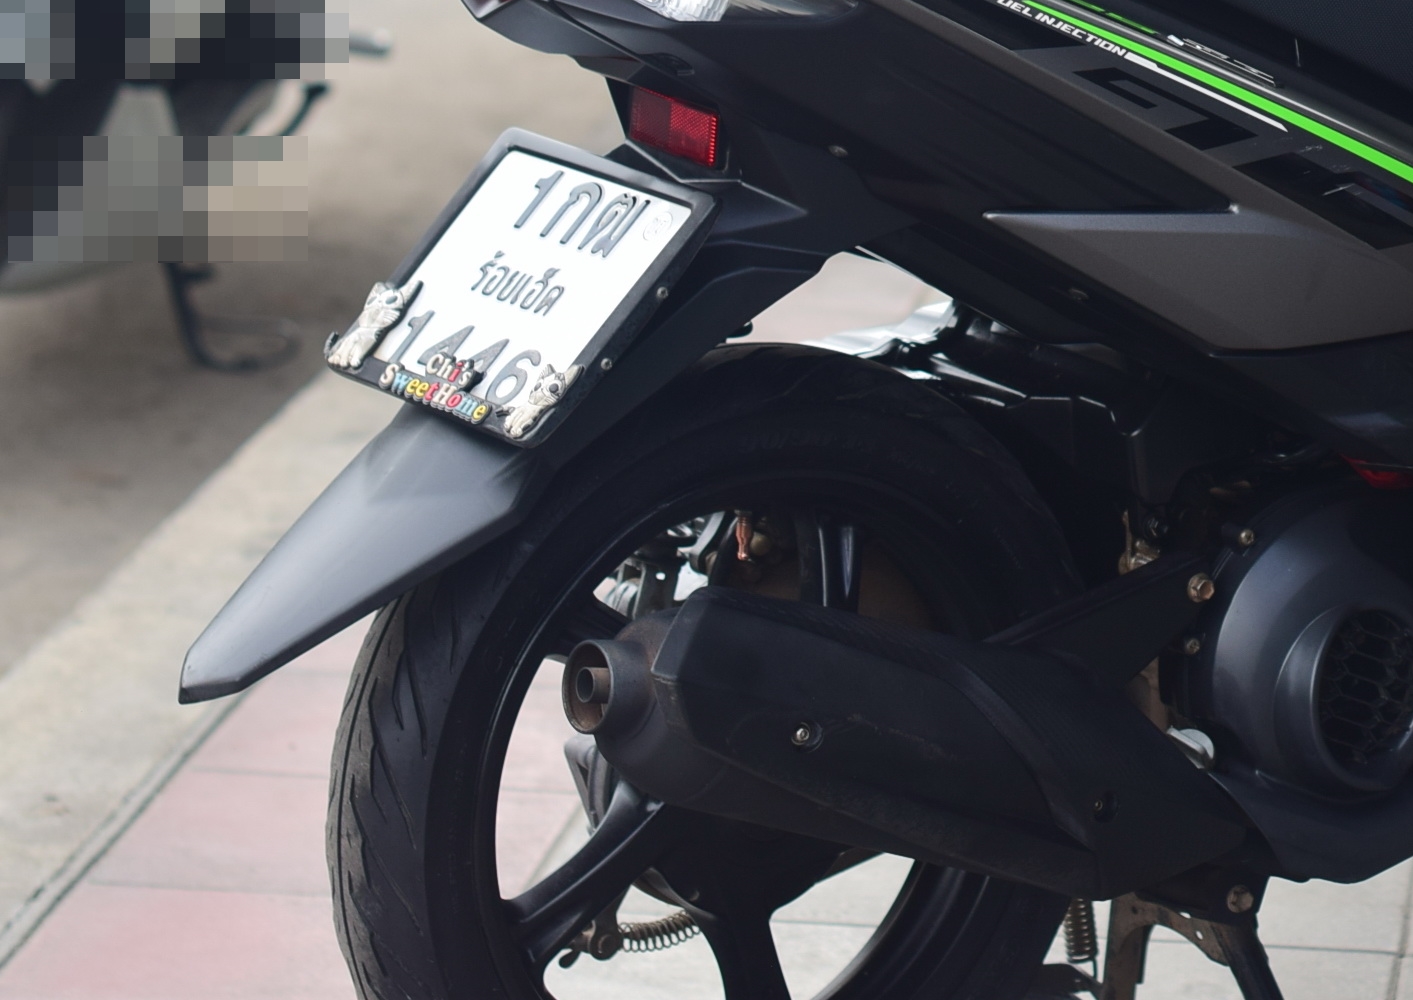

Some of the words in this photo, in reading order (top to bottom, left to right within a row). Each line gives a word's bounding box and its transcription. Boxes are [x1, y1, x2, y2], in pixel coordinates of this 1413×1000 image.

[1035, 11, 1127, 57] INJECTION
[470, 250, 565, 316] ร้อยเอ็ด
[388, 309, 542, 405] 1446
[426, 352, 474, 388] Chi's
